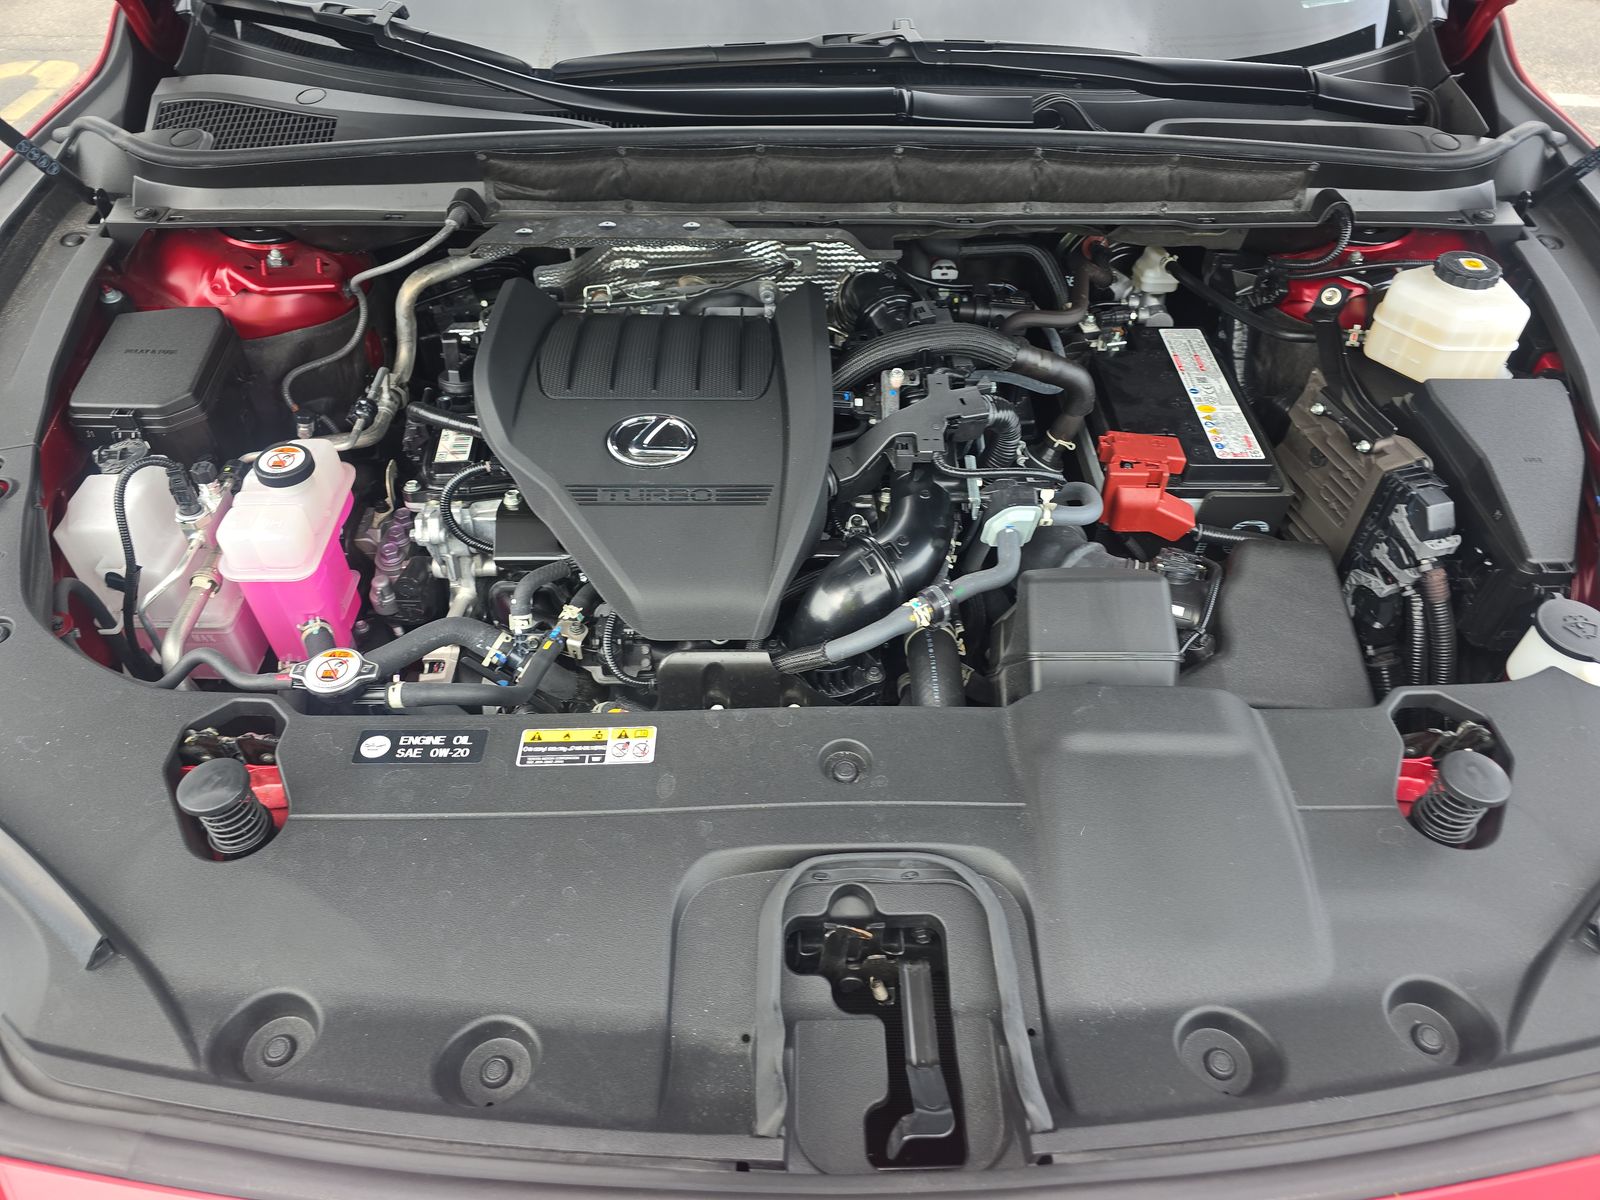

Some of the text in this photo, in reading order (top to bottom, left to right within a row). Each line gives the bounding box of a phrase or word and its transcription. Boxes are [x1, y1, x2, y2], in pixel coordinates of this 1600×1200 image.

[601, 487, 713, 502] TURBO
[399, 735, 473, 745] ENGINE OIL
[395, 748, 423, 758] SAE
